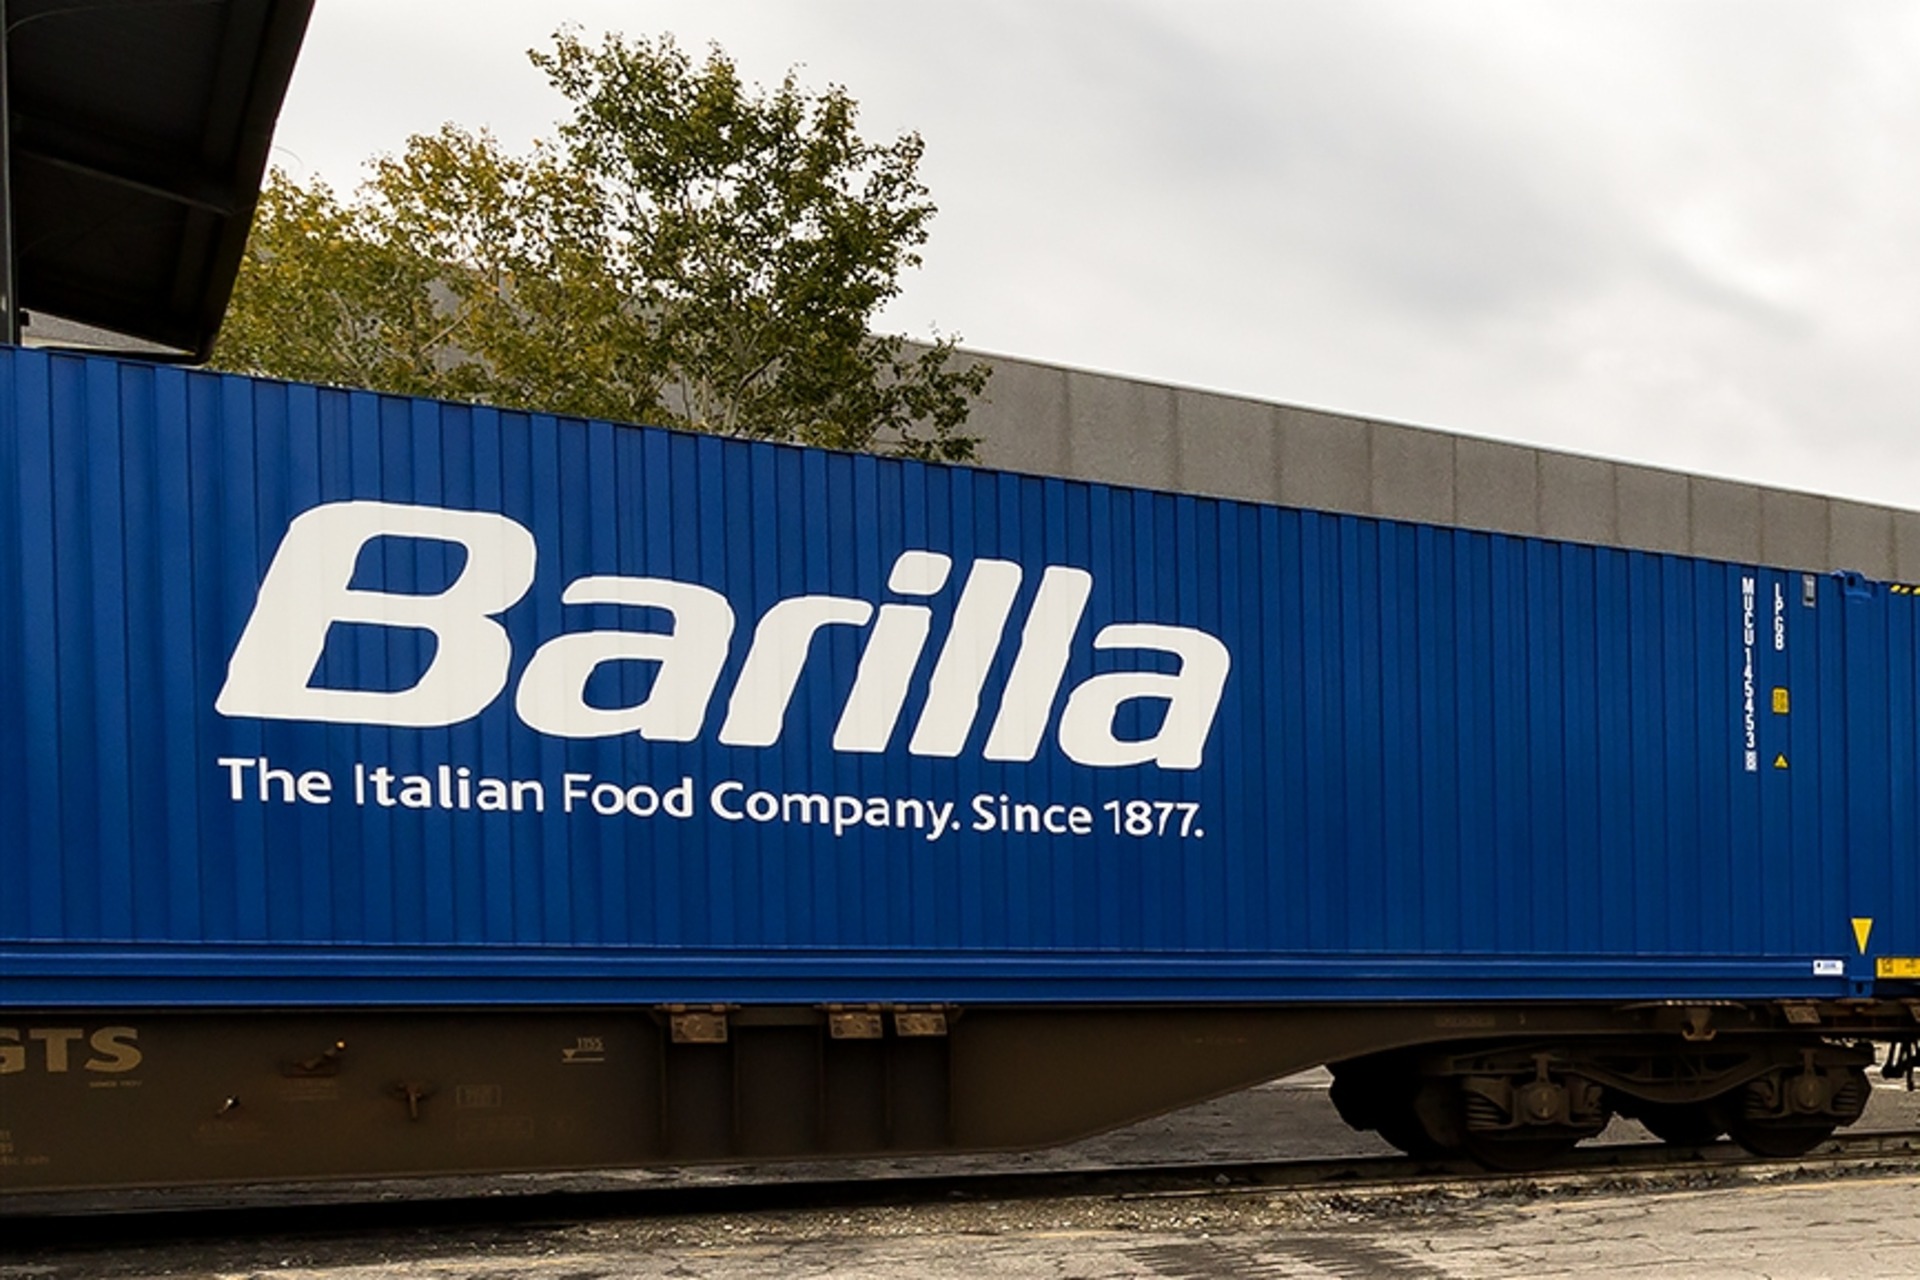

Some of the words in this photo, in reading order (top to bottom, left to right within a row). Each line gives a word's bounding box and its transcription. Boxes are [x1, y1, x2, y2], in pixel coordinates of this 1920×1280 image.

[215, 500, 1231, 770] Barilla
[217, 757, 332, 804] The
[354, 763, 544, 812] Italian
[563, 773, 693, 818] Food
[710, 781, 961, 841] Company.
[971, 794, 1093, 835] Since
[1103, 800, 1204, 838] 1877.
